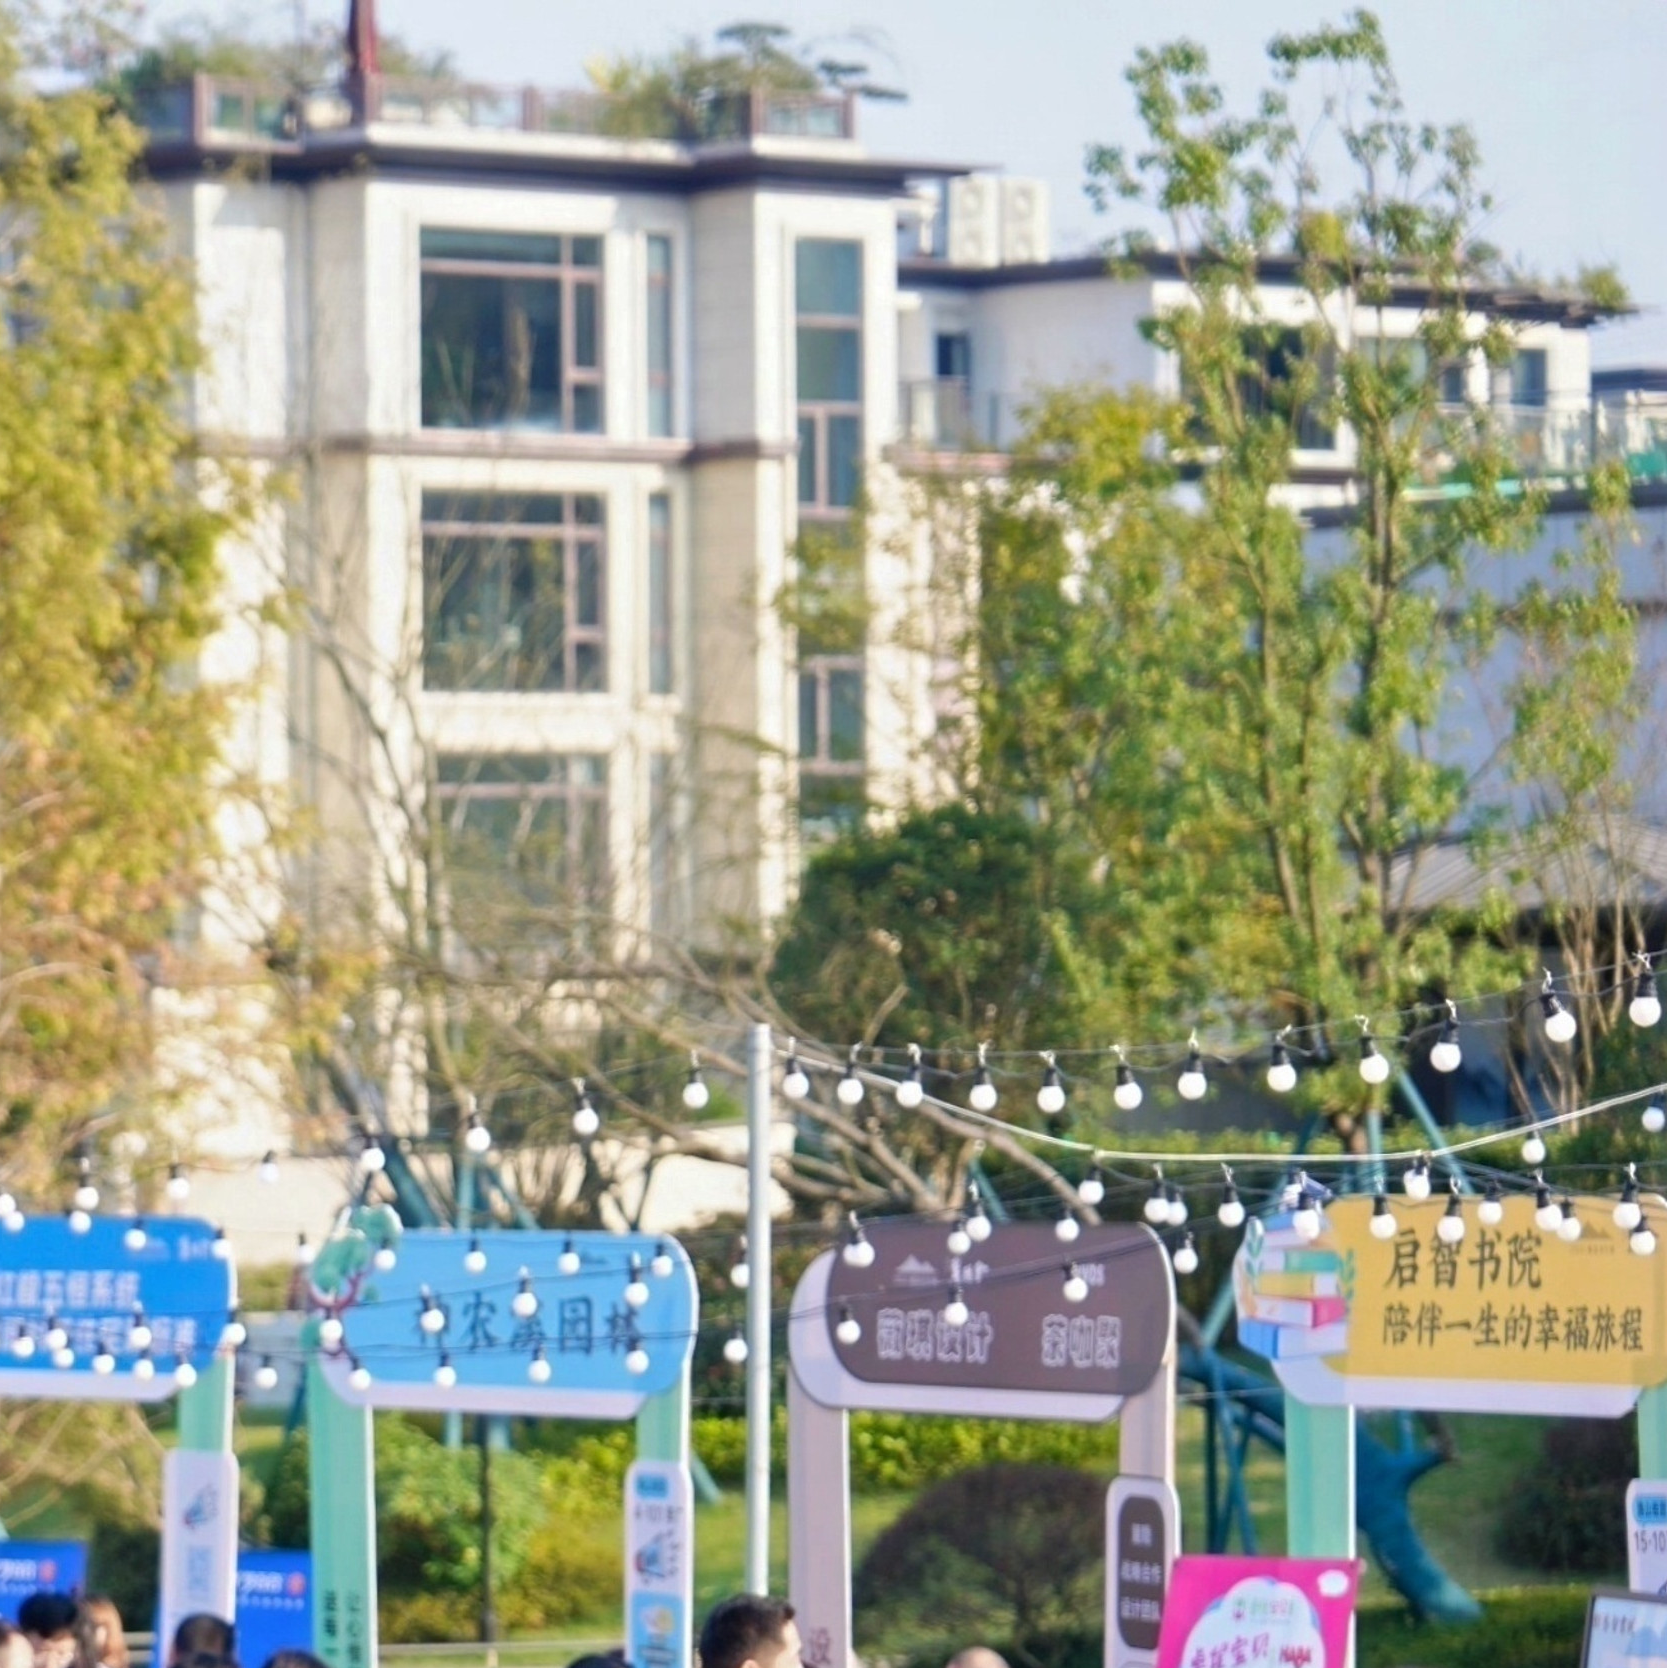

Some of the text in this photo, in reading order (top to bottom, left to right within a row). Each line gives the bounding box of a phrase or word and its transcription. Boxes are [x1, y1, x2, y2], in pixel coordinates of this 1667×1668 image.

[1384, 1227, 1542, 1291] 启智书院
[1383, 1302, 1644, 1352] 陪伴一生的幸福旅程
